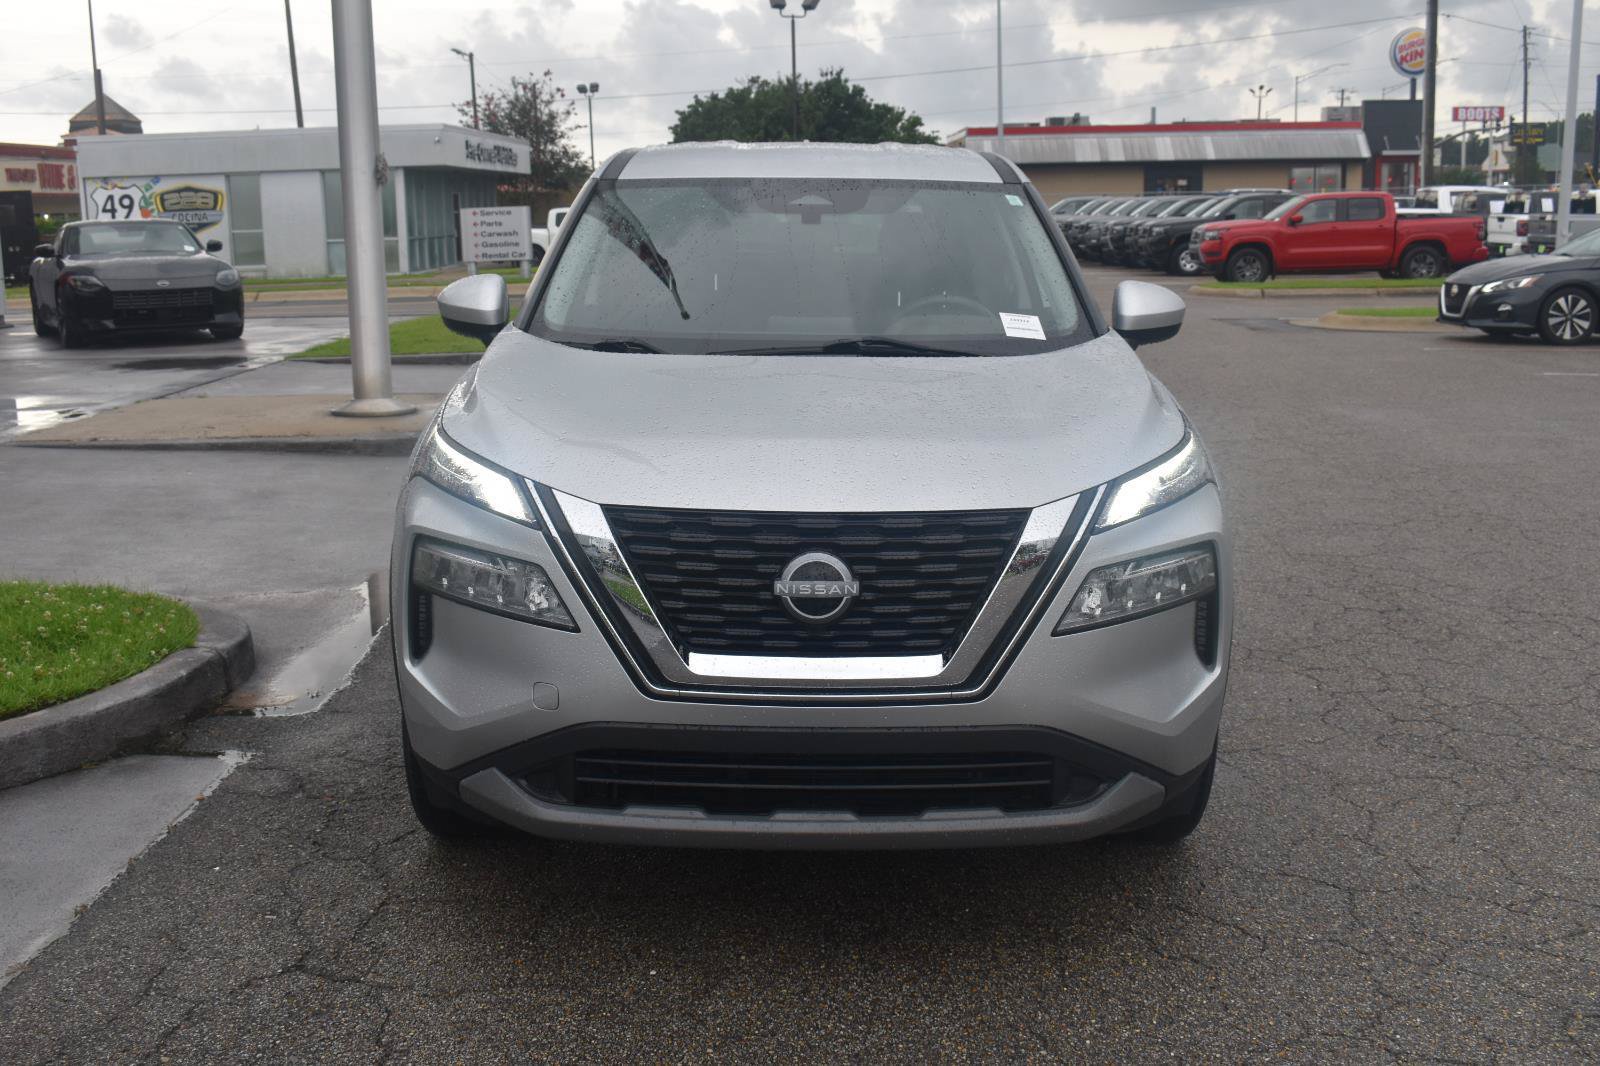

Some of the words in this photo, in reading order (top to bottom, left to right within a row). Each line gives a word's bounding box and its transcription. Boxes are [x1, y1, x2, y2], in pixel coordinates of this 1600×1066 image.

[1398, 39, 1425, 53] BURG
[1400, 49, 1425, 65] KIN
[1458, 107, 1500, 120] BOOTS
[101, 194, 134, 219] 49
[172, 213, 209, 223] COCINA
[481, 230, 519, 238] Carwash
[481, 240, 520, 248] Gasoline
[481, 252, 510, 260] Rental
[776, 583, 857, 595] NISSAN
